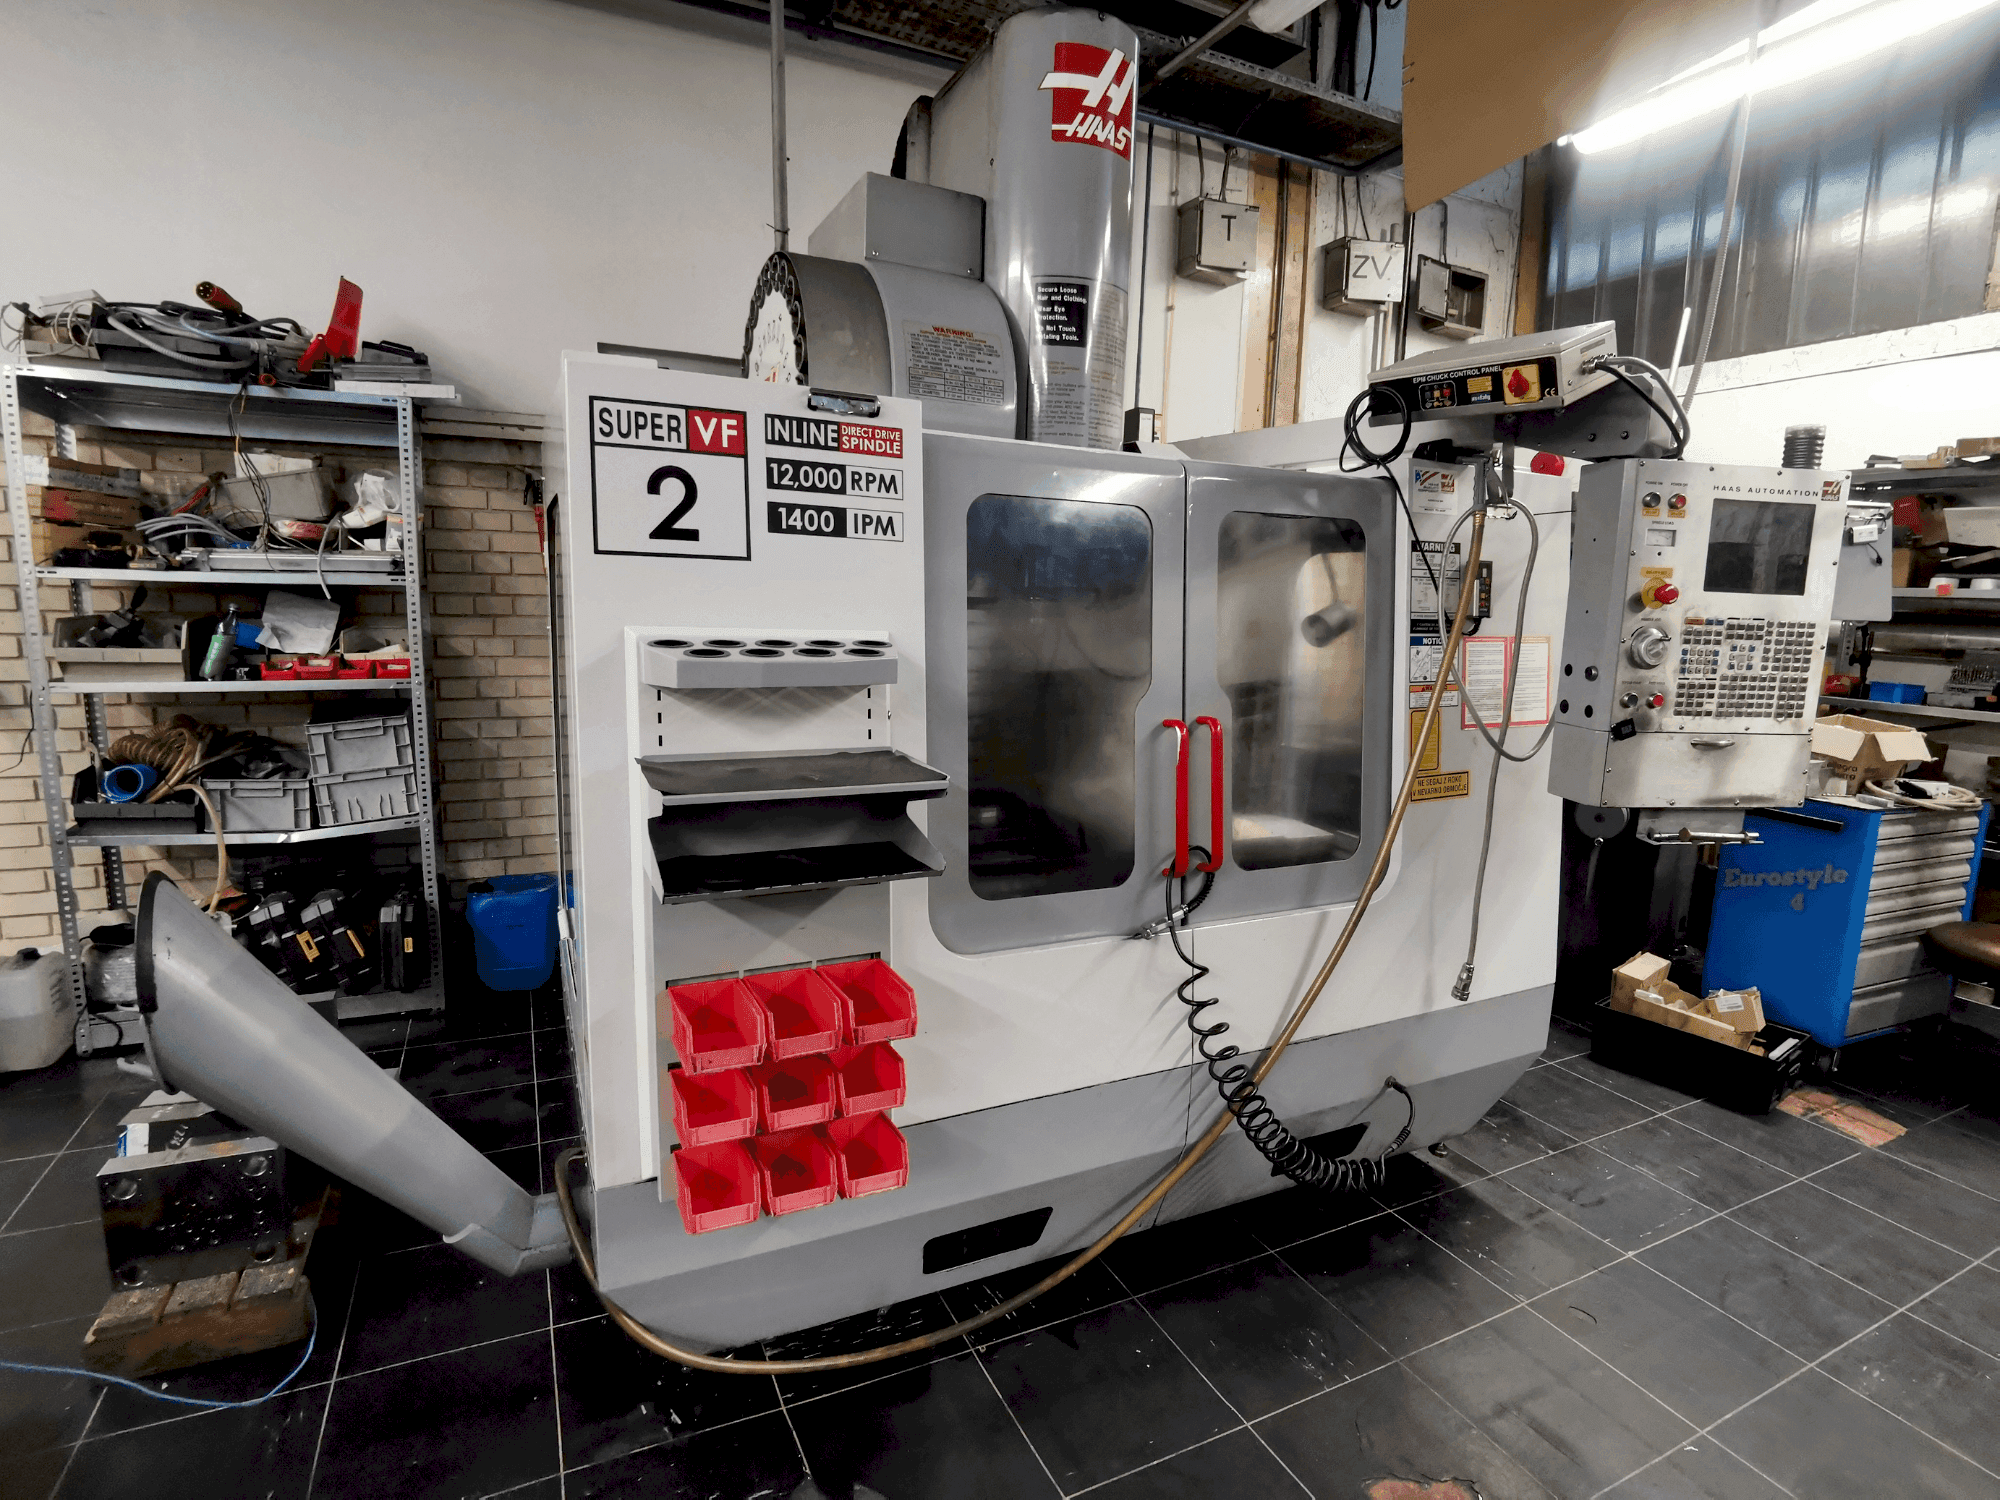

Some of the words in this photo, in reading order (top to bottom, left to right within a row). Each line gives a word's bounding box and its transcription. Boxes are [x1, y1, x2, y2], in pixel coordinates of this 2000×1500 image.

[1051, 112, 1132, 151] HAAS
[1221, 214, 1237, 241] T
[1060, 286, 1077, 294] Loose
[1054, 305, 1065, 313] Eye
[1412, 376, 1426, 384] EPM
[1426, 373, 1449, 382] CHUCK
[1449, 368, 1481, 378] CONTROL
[1481, 365, 1503, 374] PANEL
[598, 406, 683, 444] SUPER
[693, 415, 739, 448] VF
[766, 417, 839, 448] INLINE
[841, 425, 873, 439] DIRECT
[874, 428, 901, 442] DRIVE
[842, 437, 901, 455] SPINDLE
[769, 462, 843, 491] 12,000
[850, 470, 899, 496] RPM
[1713, 485, 1741, 493] HAAS
[1747, 487, 1819, 498] AUTOMATION
[646, 464, 700, 542] 2
[777, 507, 835, 533] 1400
[853, 512, 896, 537] IPM
[1416, 541, 1456, 553] WARNIG
[1422, 637, 1443, 645] NOTIC
[1723, 861, 1848, 890] Eurostyle
